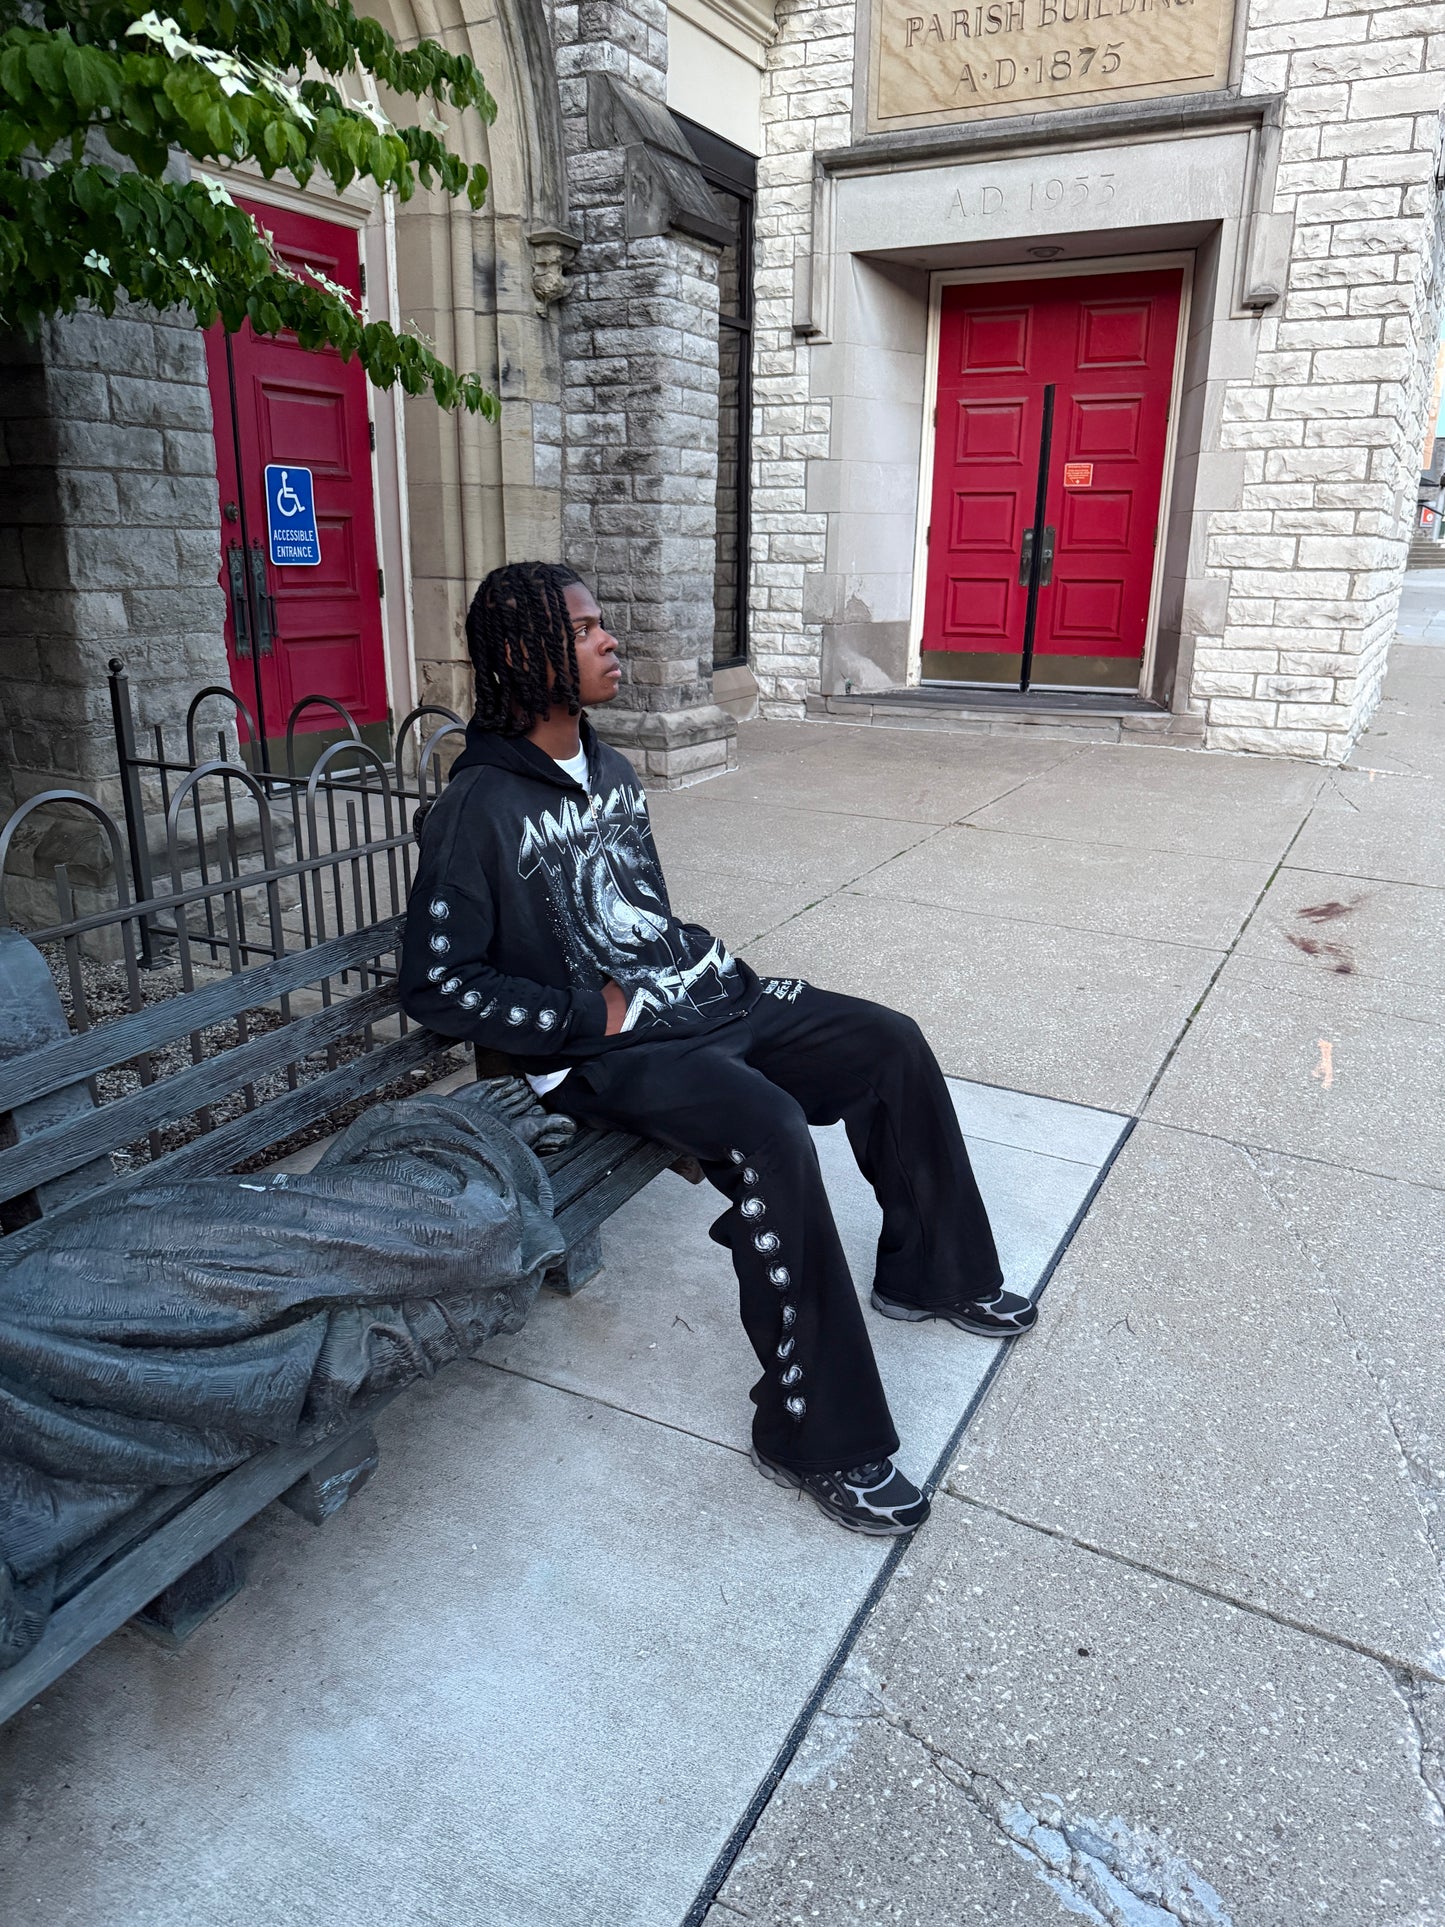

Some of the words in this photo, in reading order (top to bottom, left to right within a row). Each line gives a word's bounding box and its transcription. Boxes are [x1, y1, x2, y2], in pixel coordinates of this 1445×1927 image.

[904, 0, 1025, 48] PARISH
[273, 529, 315, 542] ACCESSIBLE
[276, 545, 313, 558] ENTRANCE
